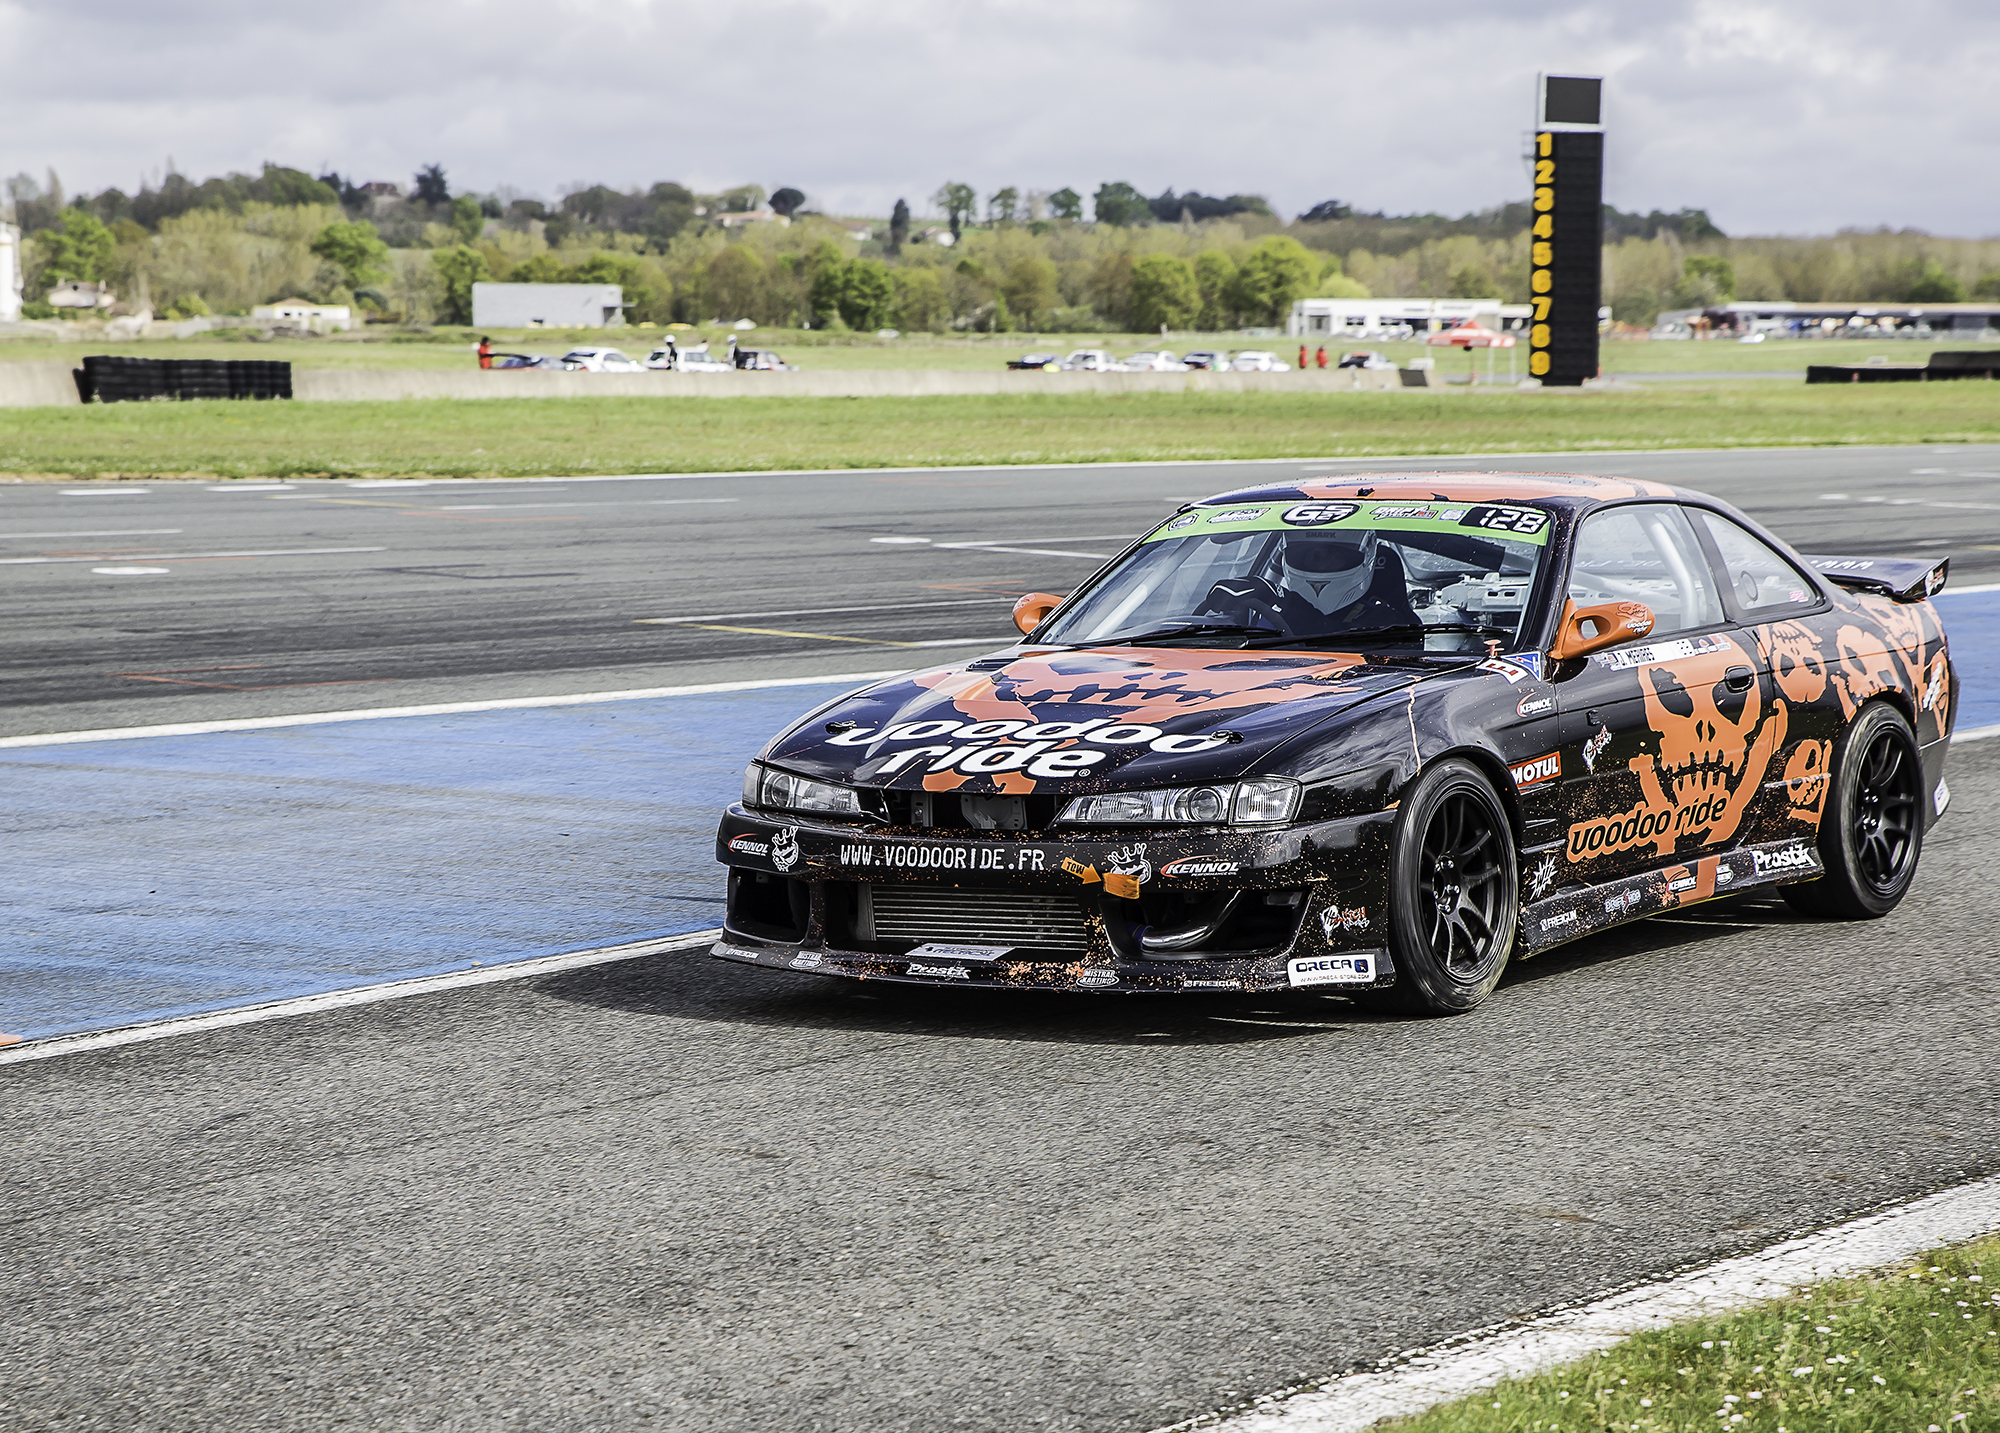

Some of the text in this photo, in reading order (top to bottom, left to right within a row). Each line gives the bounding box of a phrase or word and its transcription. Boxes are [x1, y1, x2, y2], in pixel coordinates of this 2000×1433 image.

[1536, 132, 1552, 157] 1
[1534, 160, 1555, 184] 2
[1534, 187, 1554, 212] 3
[1533, 214, 1553, 239] 4
[1532, 241, 1552, 266] 5
[1532, 269, 1552, 294] 6
[1531, 296, 1552, 321] 7
[1531, 324, 1551, 348] 8
[1530, 351, 1551, 376] 9
[1479, 509, 1547, 533] 128
[1305, 531, 1337, 539] SHARK
[1519, 697, 1552, 714] KENNOL
[1511, 756, 1559, 784] MOTUL
[1571, 793, 1728, 855] voodoo ride
[730, 839, 769, 854] KENNOL
[840, 844, 1046, 870] WWW.VOODOORIDE.FR
[1066, 860, 1086, 875] TOW
[1165, 861, 1239, 874] KENNOL
[1668, 876, 1697, 890] KENNOL
[1295, 959, 1352, 973] ORECA
